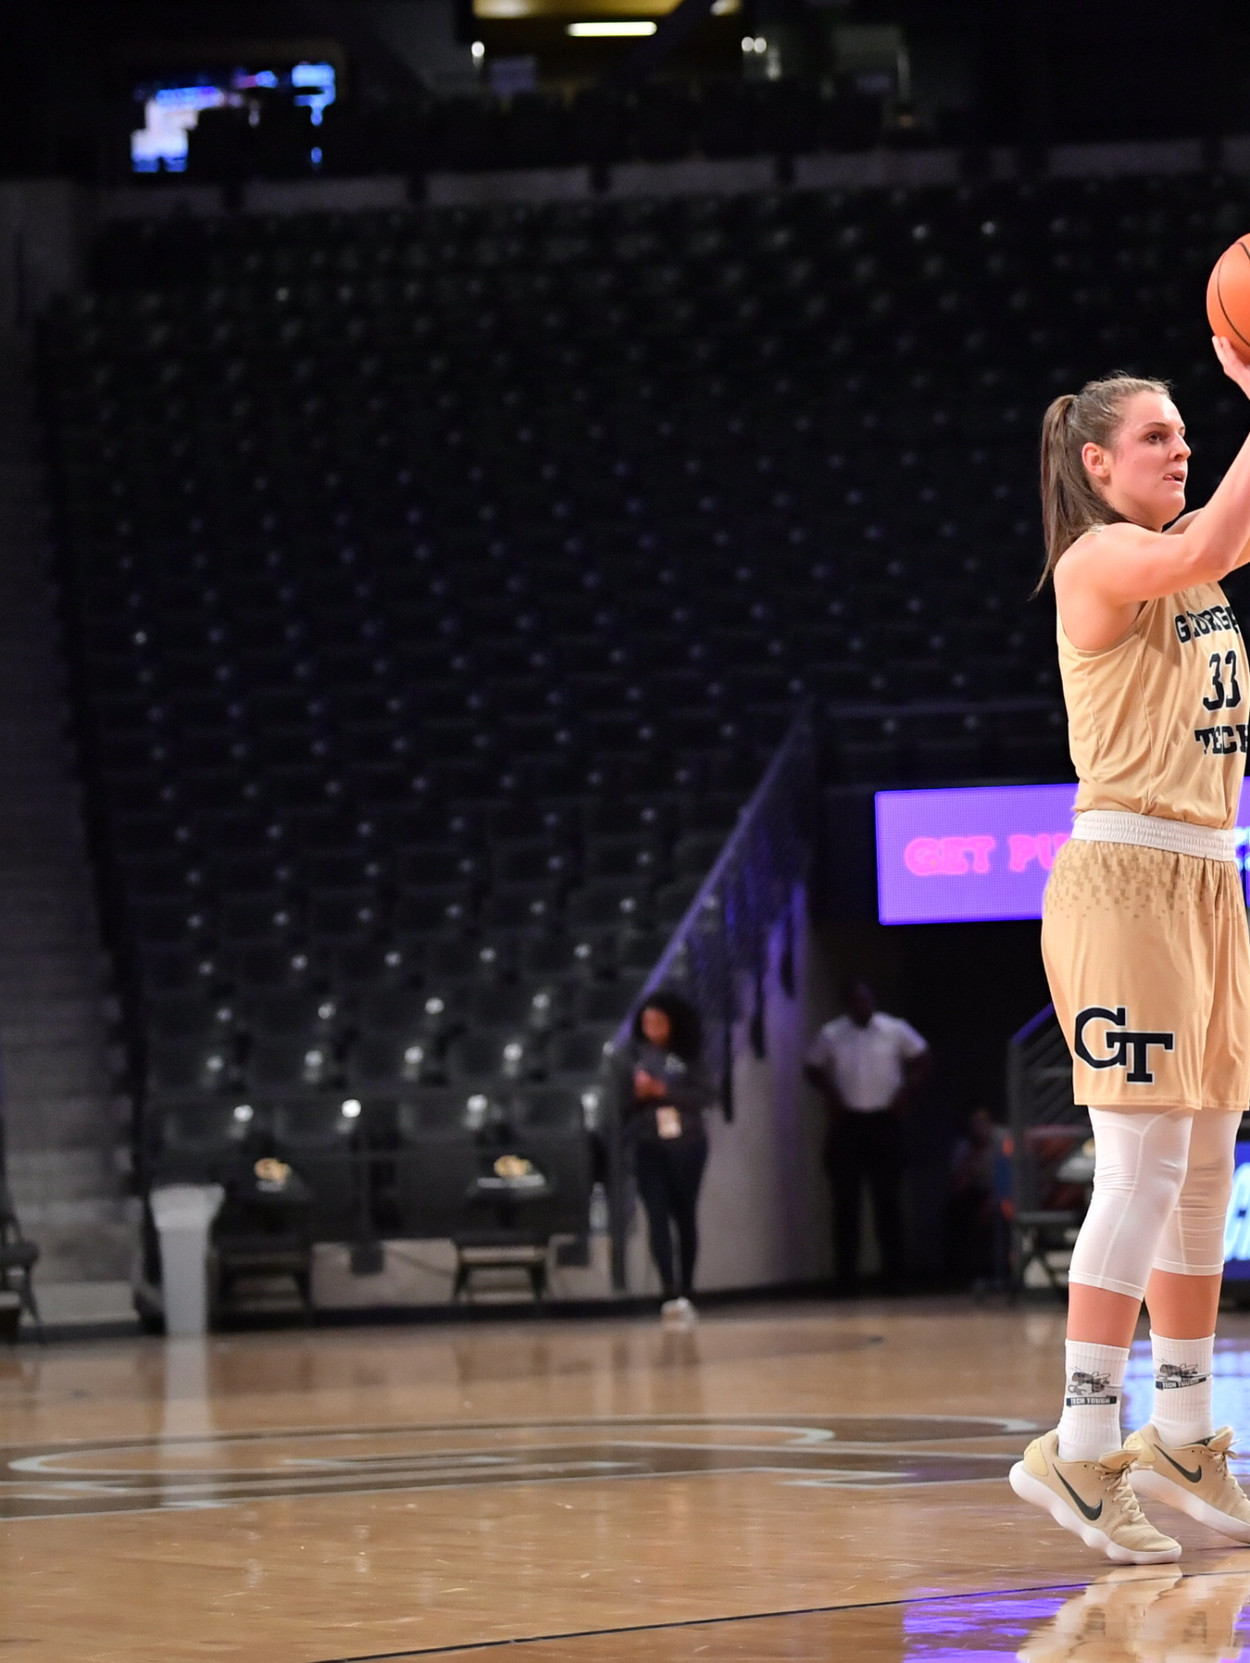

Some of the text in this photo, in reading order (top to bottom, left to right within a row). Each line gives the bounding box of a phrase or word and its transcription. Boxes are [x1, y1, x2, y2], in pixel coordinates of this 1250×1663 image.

[1202, 650, 1242, 712] 33
[904, 836, 997, 876] GET
[1074, 1006, 1174, 1083] GT
